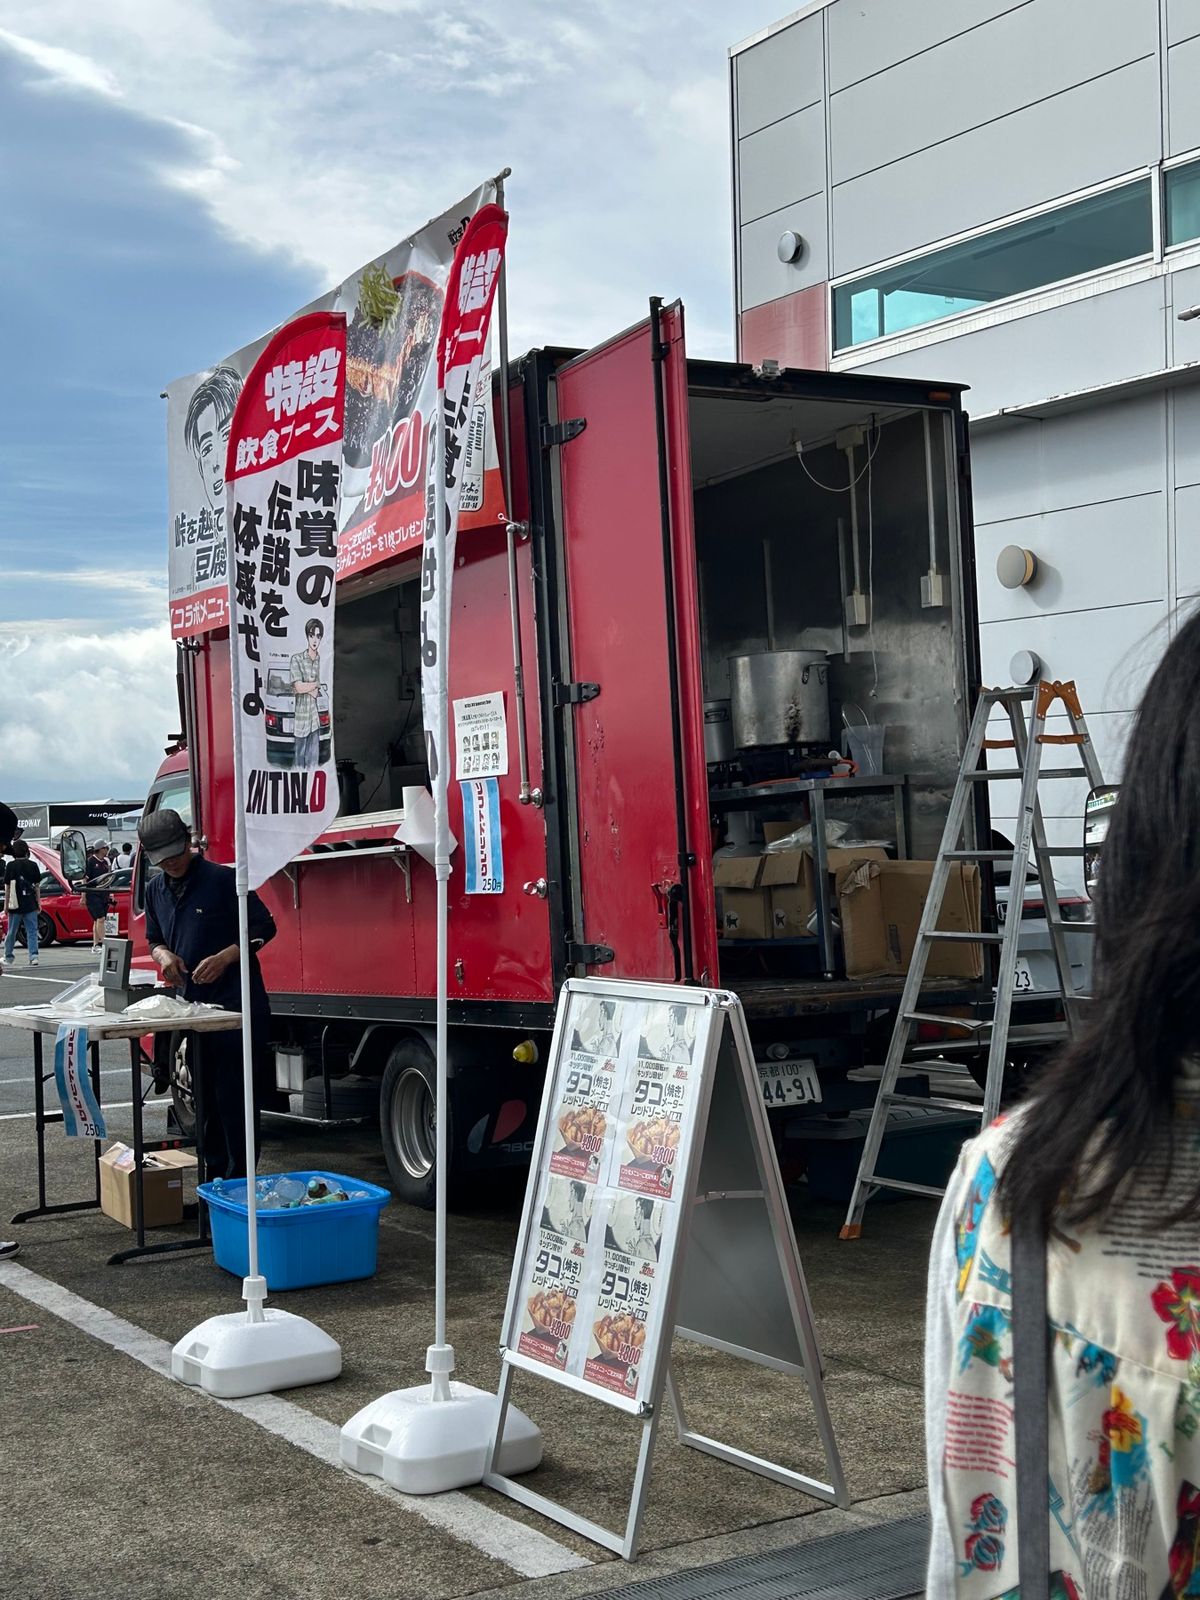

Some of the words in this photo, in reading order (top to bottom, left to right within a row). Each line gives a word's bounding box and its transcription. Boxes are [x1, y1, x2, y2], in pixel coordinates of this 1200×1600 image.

[265, 346, 341, 422] 特設
[235, 404, 339, 473] 飲食ブース
[475, 410, 485, 451] Takumi
[465, 420, 476, 468] Fujiwara
[294, 459, 340, 607] 味覚の
[195, 538, 227, 583] 豆腐
[259, 480, 293, 638] 伝説を
[233, 502, 265, 716] 体感せよ
[246, 769, 309, 815] INITIAL
[309, 770, 327, 813] D
[482, 878, 502, 891] 250円
[565, 1071, 593, 1096] タコ
[760, 1064, 799, 1078] 京都100
[590, 1088, 611, 1100] メーター
[634, 1079, 664, 1106] タコ
[661, 1097, 684, 1109] メーター
[762, 1077, 816, 1103] 44-91
[581, 1133, 603, 1153] ¥800
[651, 1145, 676, 1166] ¥800
[535, 1249, 562, 1279] タコ
[559, 1271, 581, 1285] メーター
[600, 1271, 630, 1301] タコ
[628, 1293, 650, 1307] メーター
[549, 1318, 571, 1340] ¥800
[617, 1341, 642, 1366] ¥800
